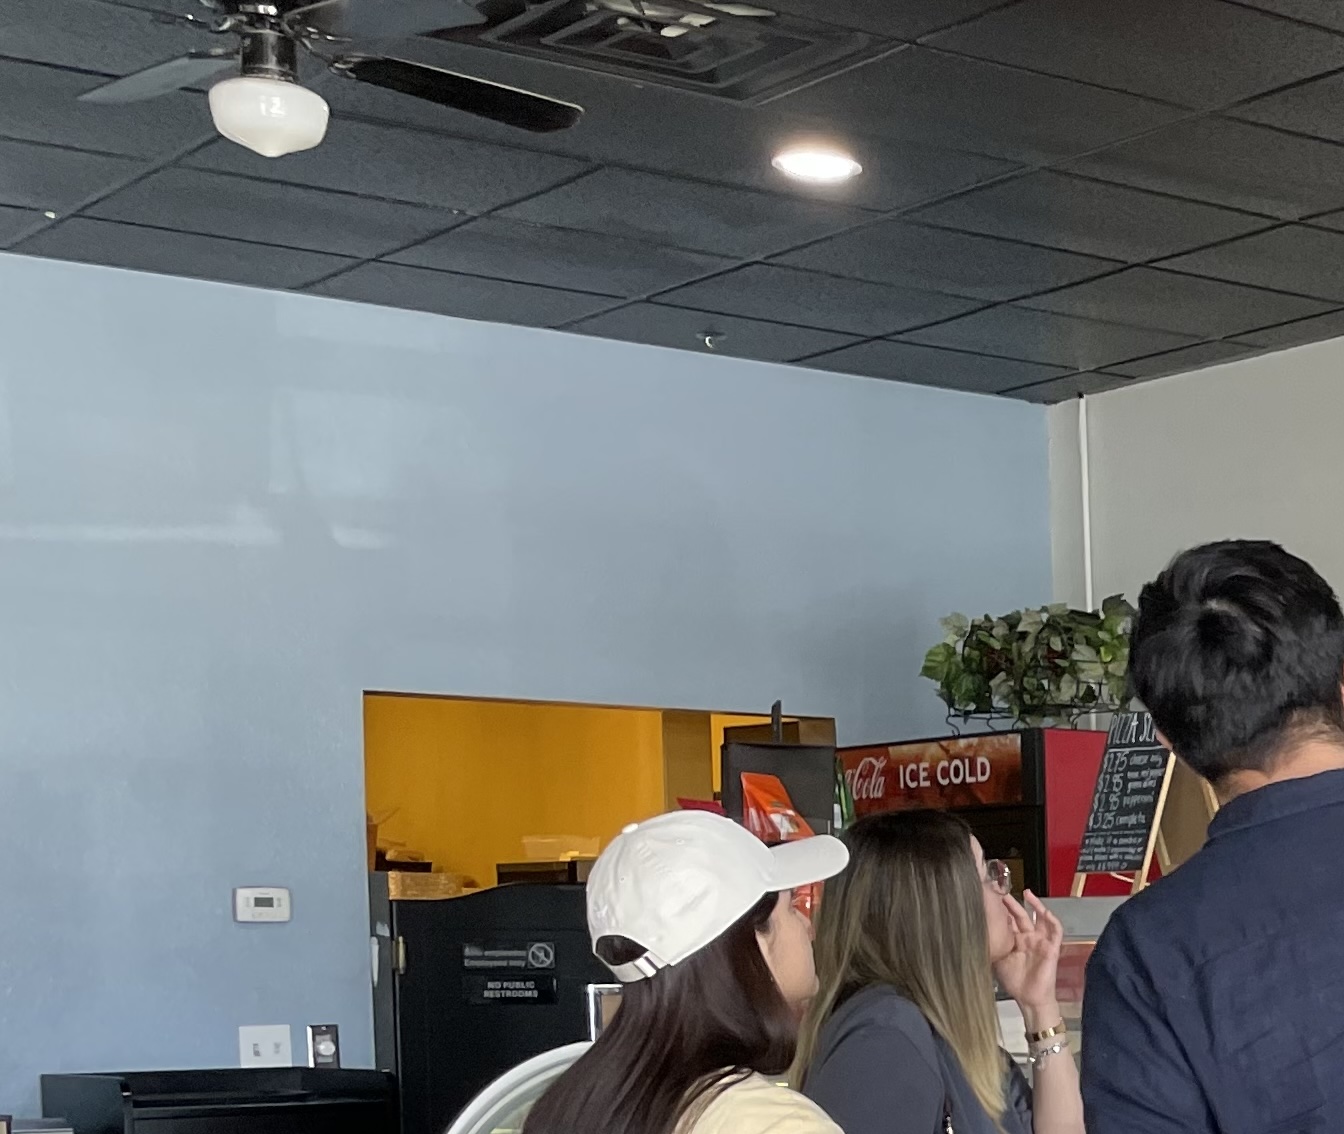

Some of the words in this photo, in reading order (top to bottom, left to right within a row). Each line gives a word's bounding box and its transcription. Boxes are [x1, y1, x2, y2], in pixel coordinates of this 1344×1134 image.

[900, 762, 931, 789] ICE
[937, 756, 991, 786] COLD
[487, 981, 502, 989] NO
[503, 981, 535, 989] PUBLIC
[483, 989, 538, 998] RESTROOMS
